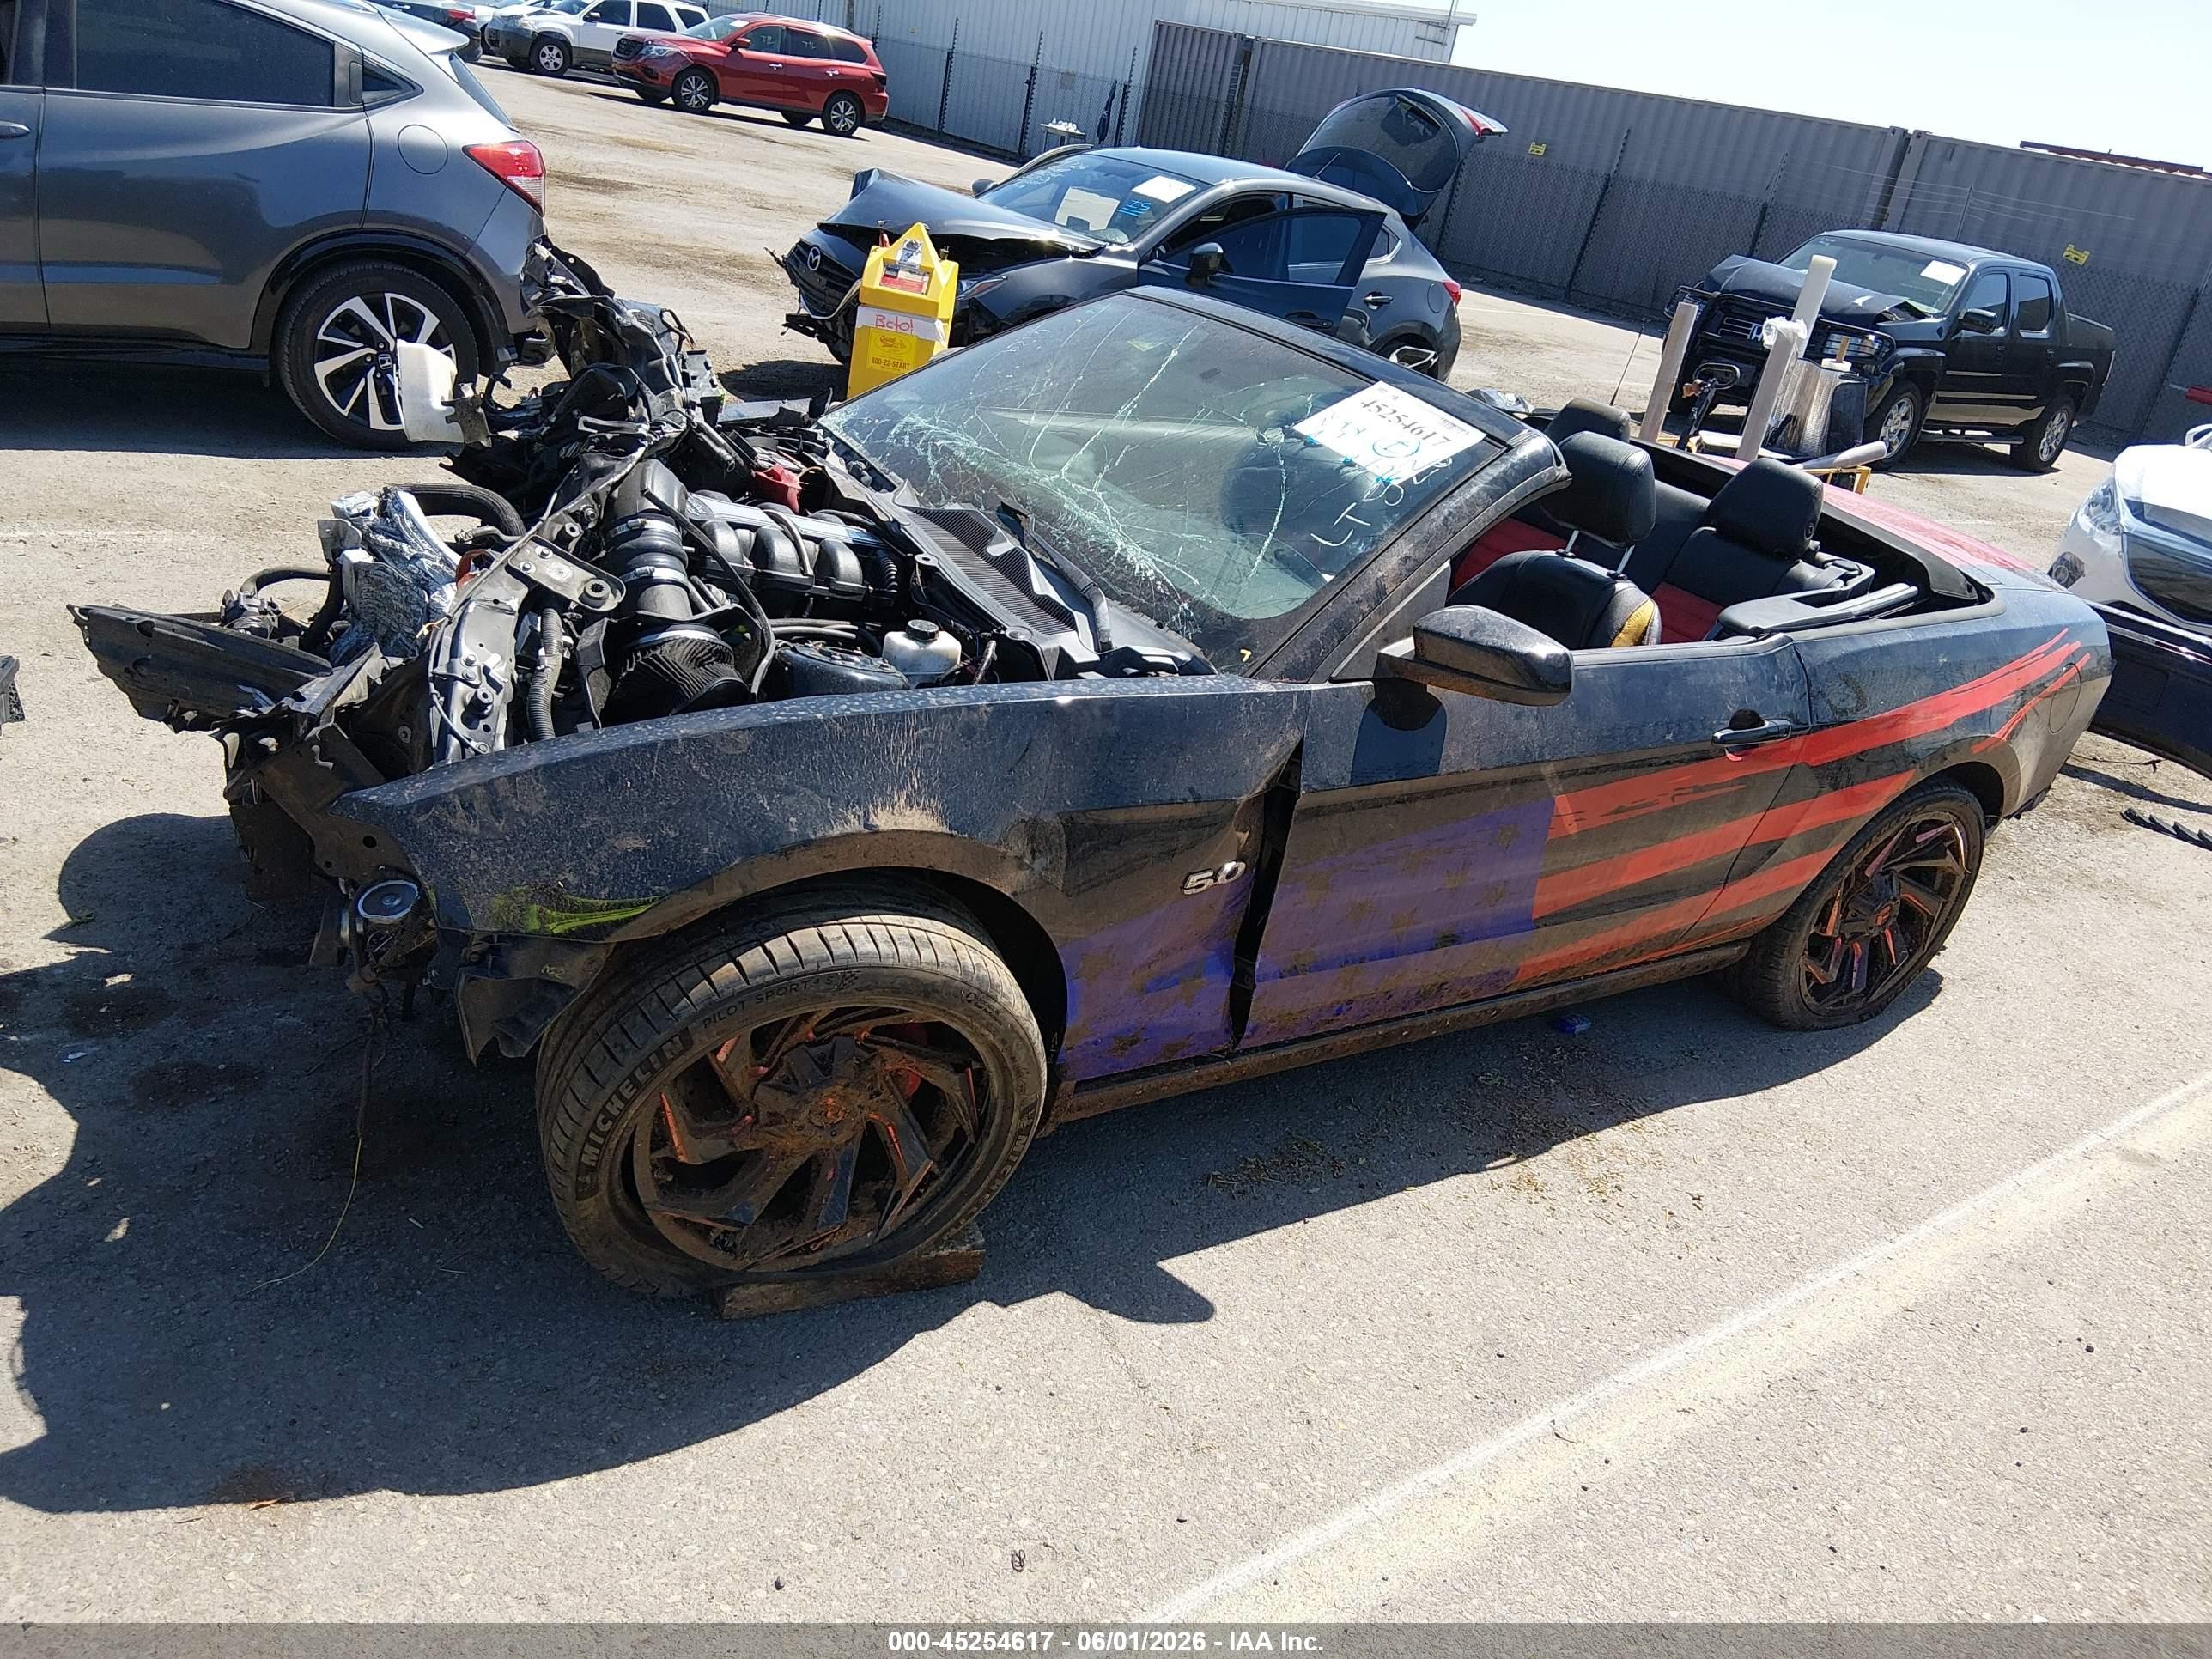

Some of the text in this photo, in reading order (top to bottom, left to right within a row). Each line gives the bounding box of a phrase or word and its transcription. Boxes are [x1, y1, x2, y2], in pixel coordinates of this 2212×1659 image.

[1359, 398, 1453, 447] 45254617
[702, 1000, 748, 1029] PILOT
[755, 980, 811, 1004] SPORT
[580, 1033, 688, 1169] MICHELIN
